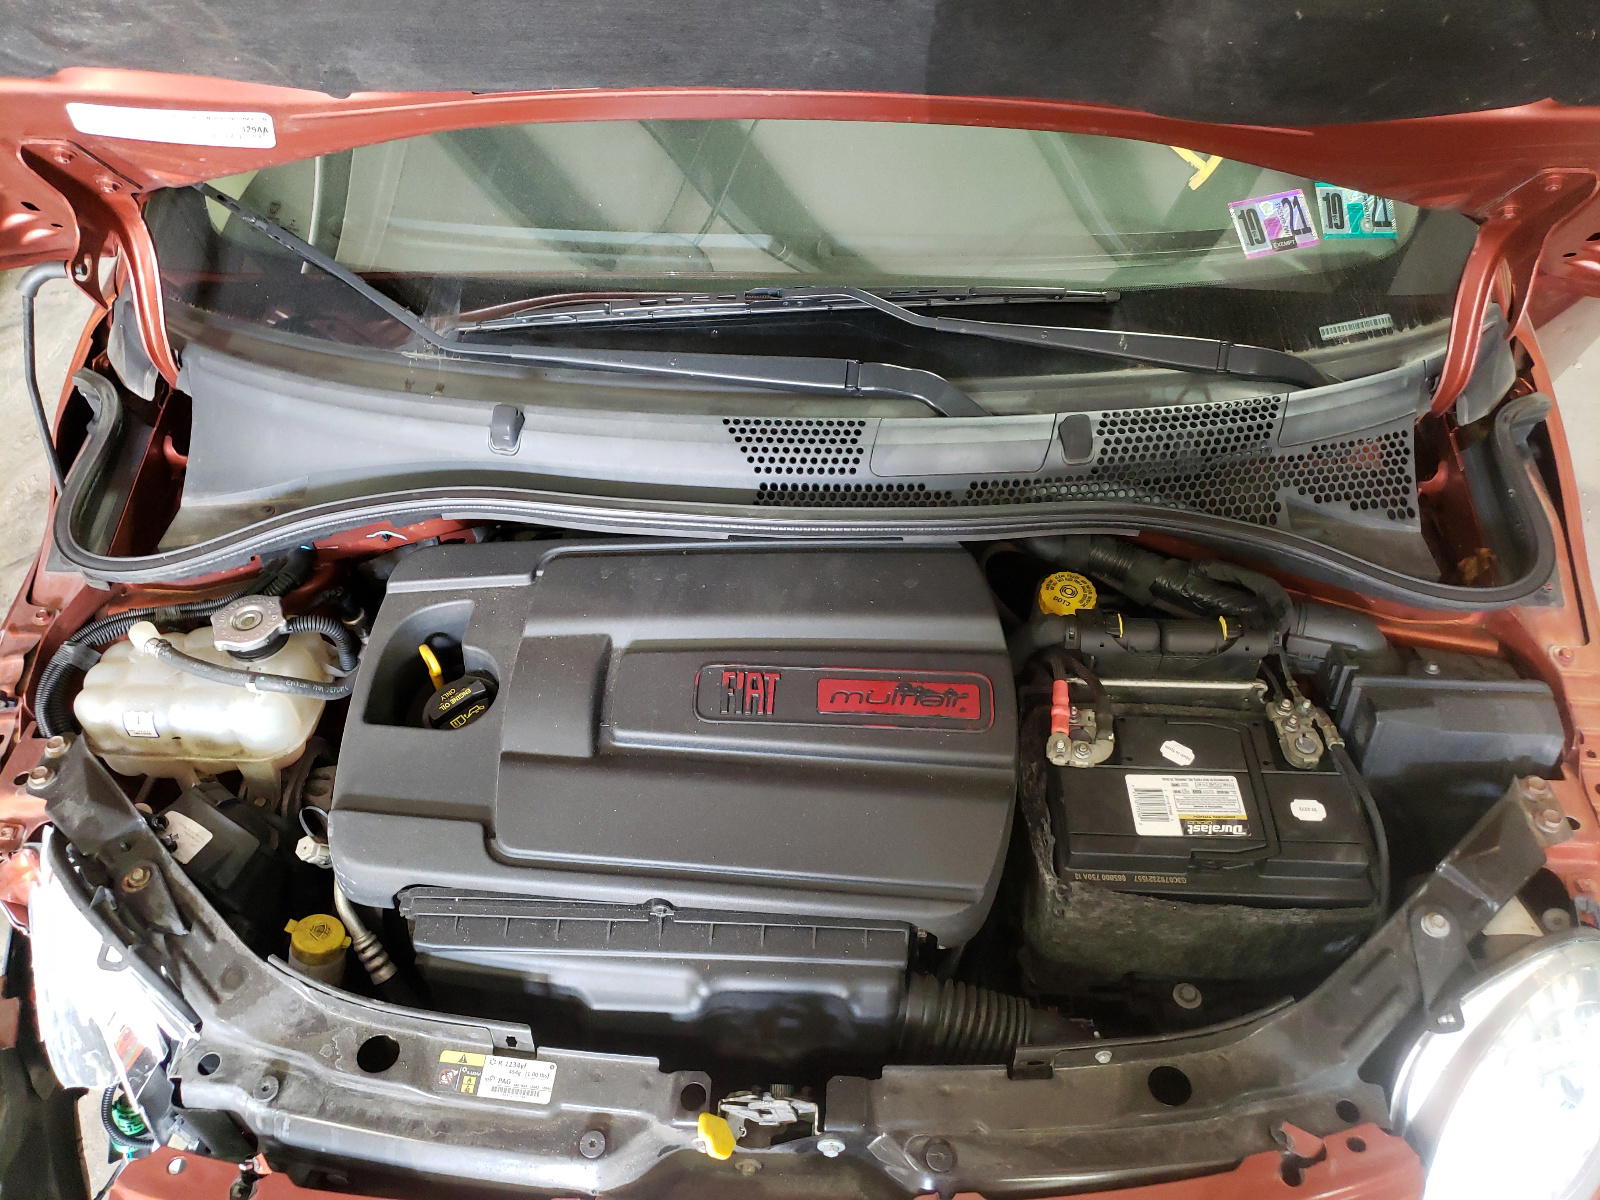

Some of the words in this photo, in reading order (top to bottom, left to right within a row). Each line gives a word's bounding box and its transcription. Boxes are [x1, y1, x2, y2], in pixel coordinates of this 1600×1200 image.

[1282, 195, 1312, 236] 21
[1273, 238, 1297, 249] EXEMPT
[440, 688, 456, 702] ONLY
[449, 687, 472, 705] ENGINE
[719, 671, 782, 716] FIAT
[438, 701, 450, 711] OIL
[1187, 824, 1247, 835] Duralast
